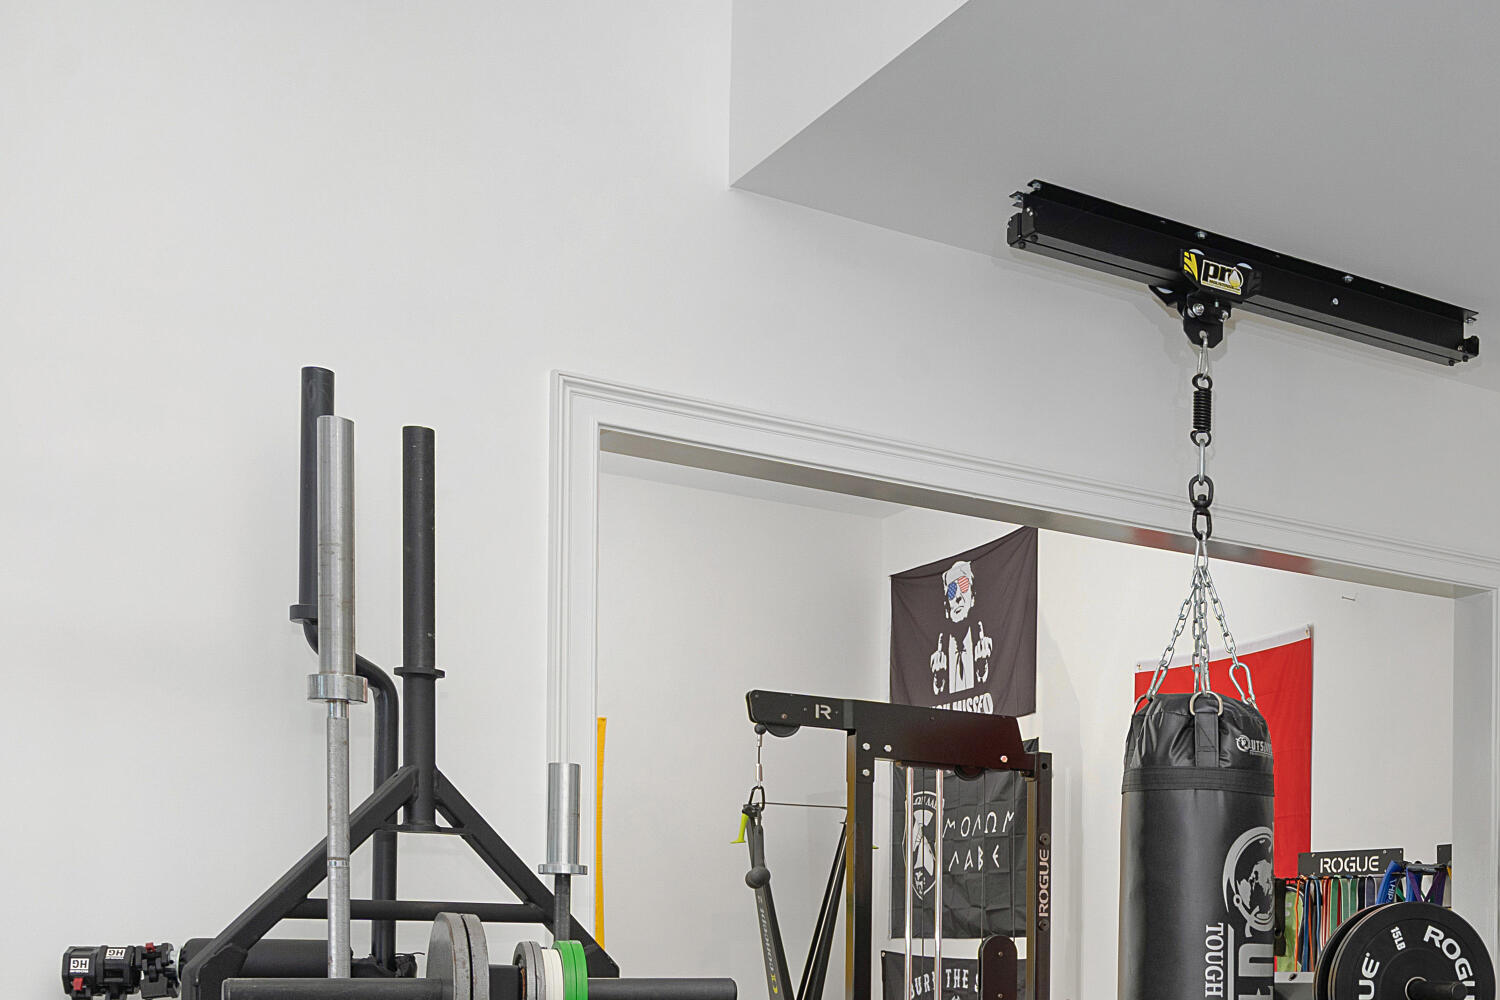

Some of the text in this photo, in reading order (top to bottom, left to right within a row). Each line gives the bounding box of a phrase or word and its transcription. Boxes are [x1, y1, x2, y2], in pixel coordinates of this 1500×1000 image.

[1319, 855, 1380, 874] ROGUE
[1039, 850, 1050, 918] ROGUE
[1390, 926, 1406, 951] 15LB
[1205, 922, 1224, 998] TOUGH
[945, 968, 969, 989] THE
